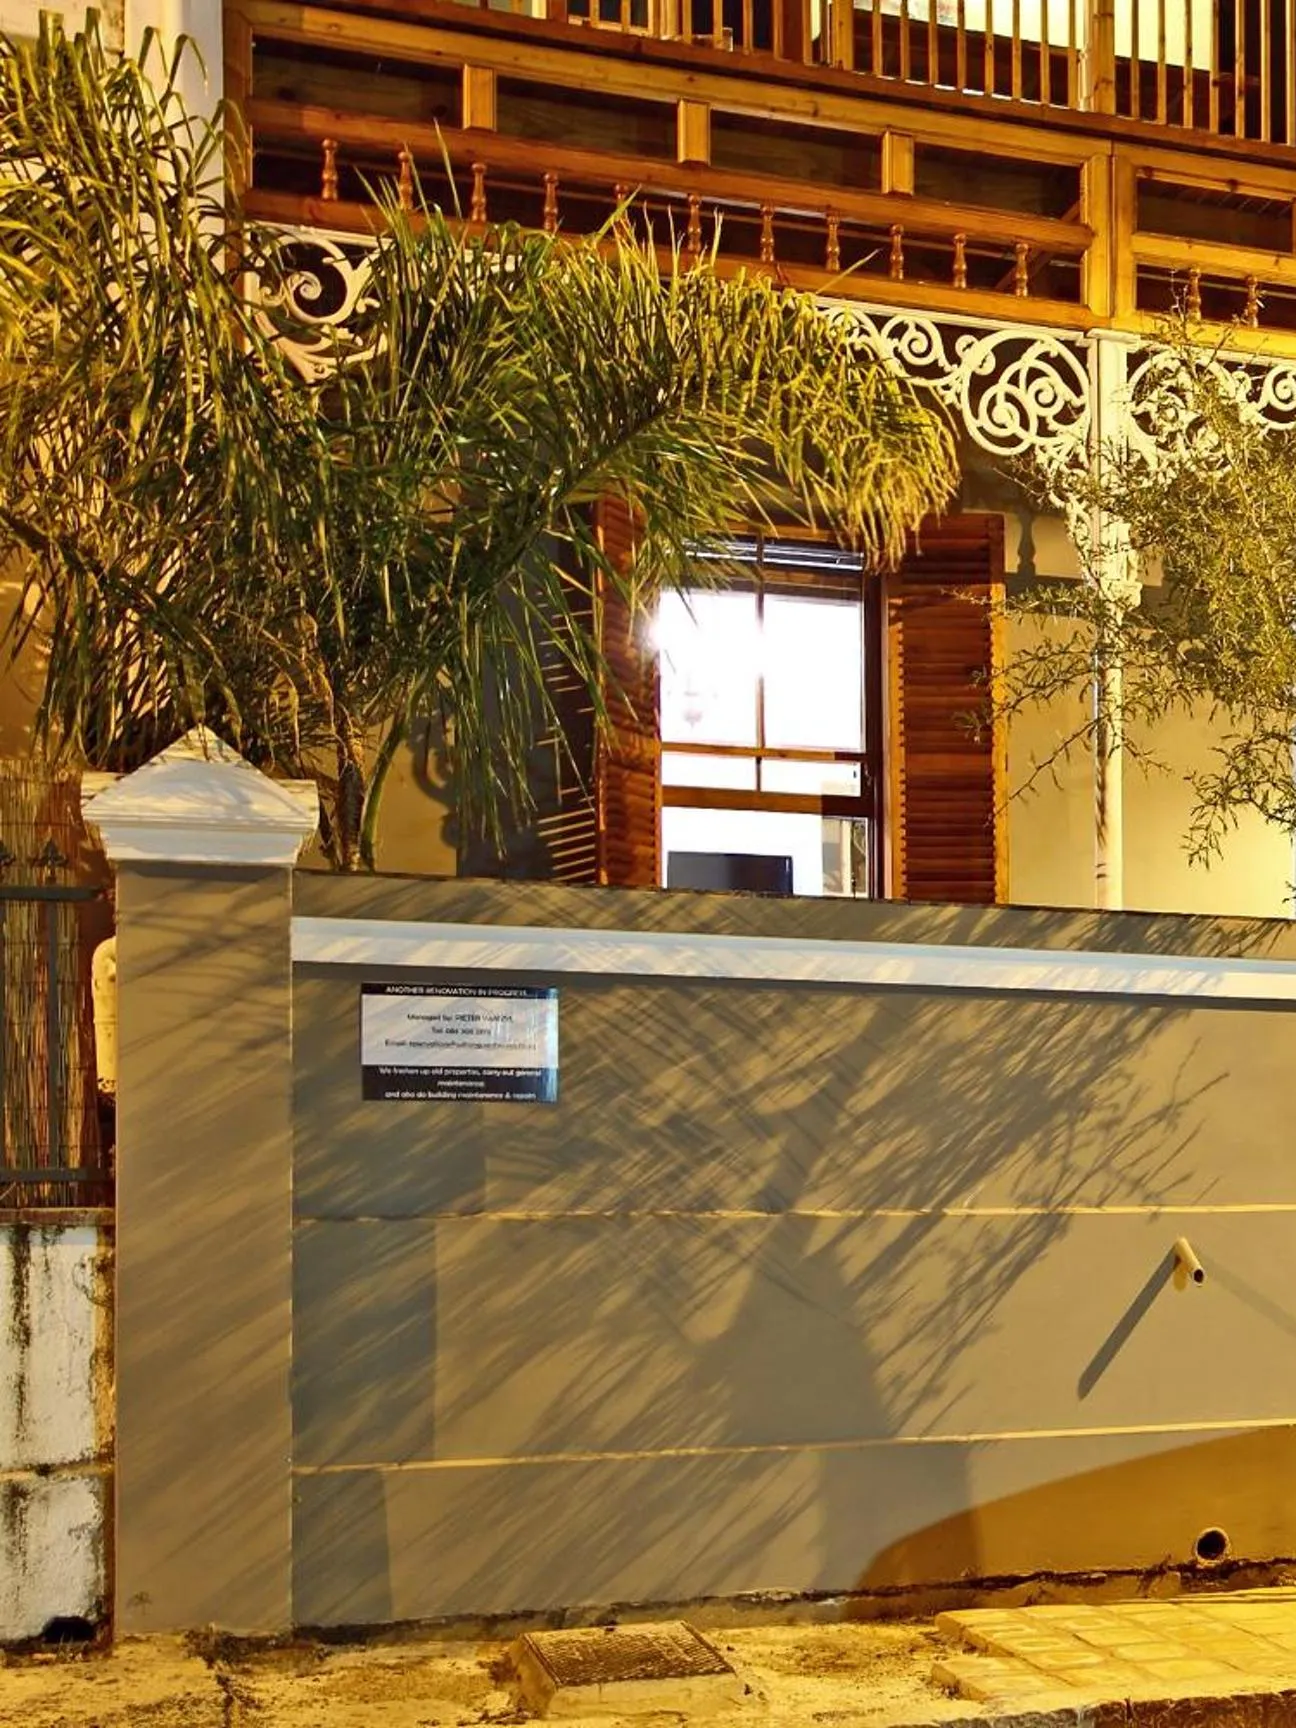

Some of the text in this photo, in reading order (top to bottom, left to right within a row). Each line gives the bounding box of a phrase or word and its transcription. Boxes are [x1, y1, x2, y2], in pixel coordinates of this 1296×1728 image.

[385, 986, 424, 994] ANOTHER
[425, 986, 476, 995] RENOVATION
[478, 988, 487, 996] IN
